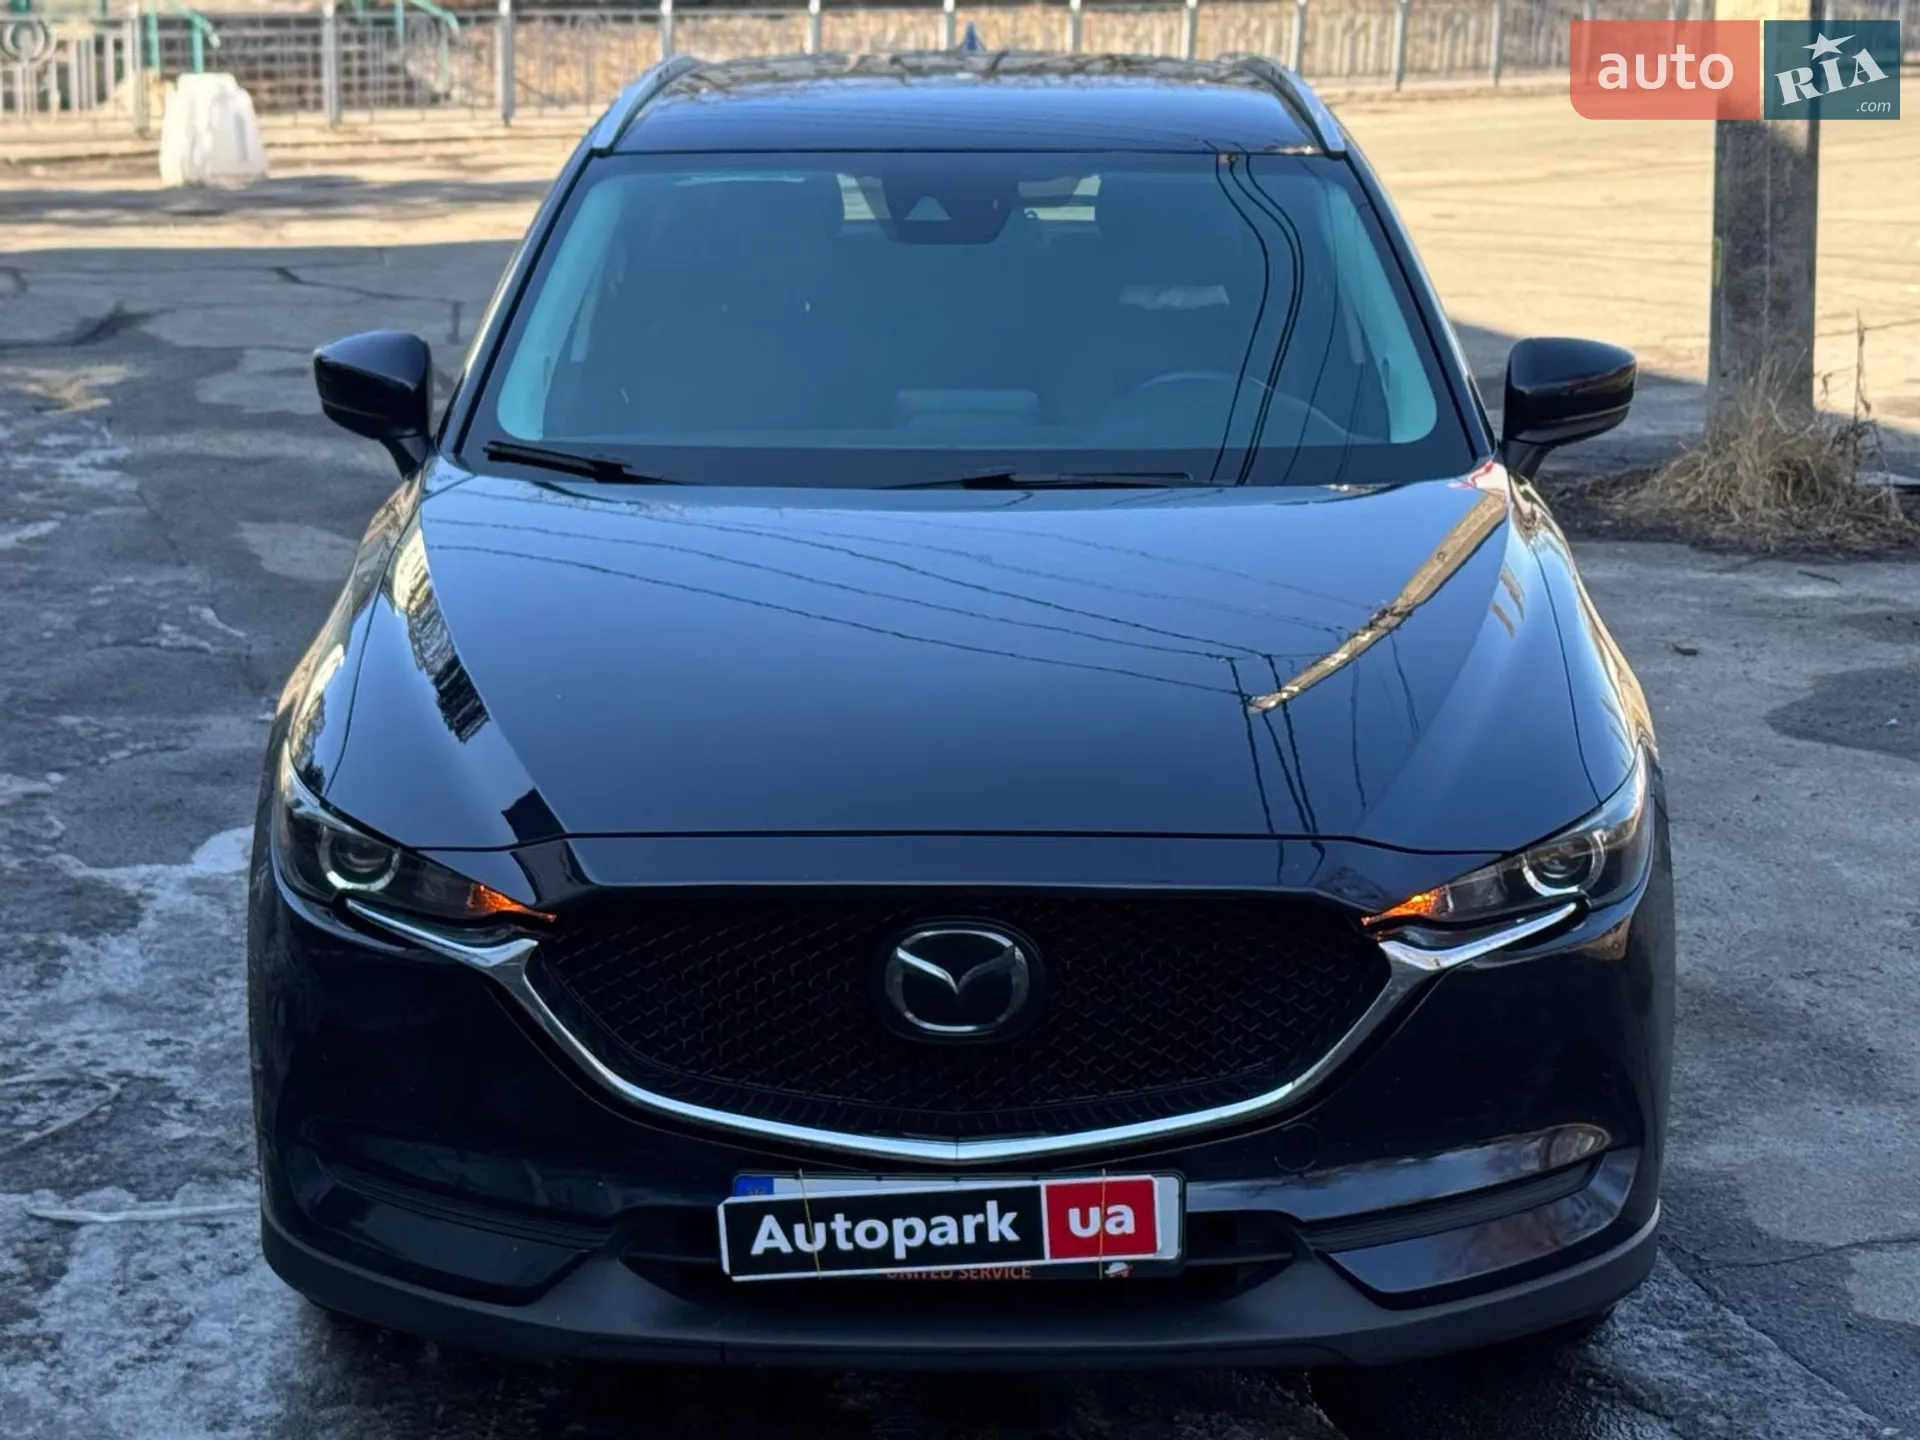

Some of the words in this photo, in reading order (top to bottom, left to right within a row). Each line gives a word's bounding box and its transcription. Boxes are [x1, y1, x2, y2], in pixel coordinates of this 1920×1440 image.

[750, 1200, 1020, 1260] Autopark
[1068, 1203, 1136, 1238] ua
[958, 1266, 1031, 1280] SERVICE
